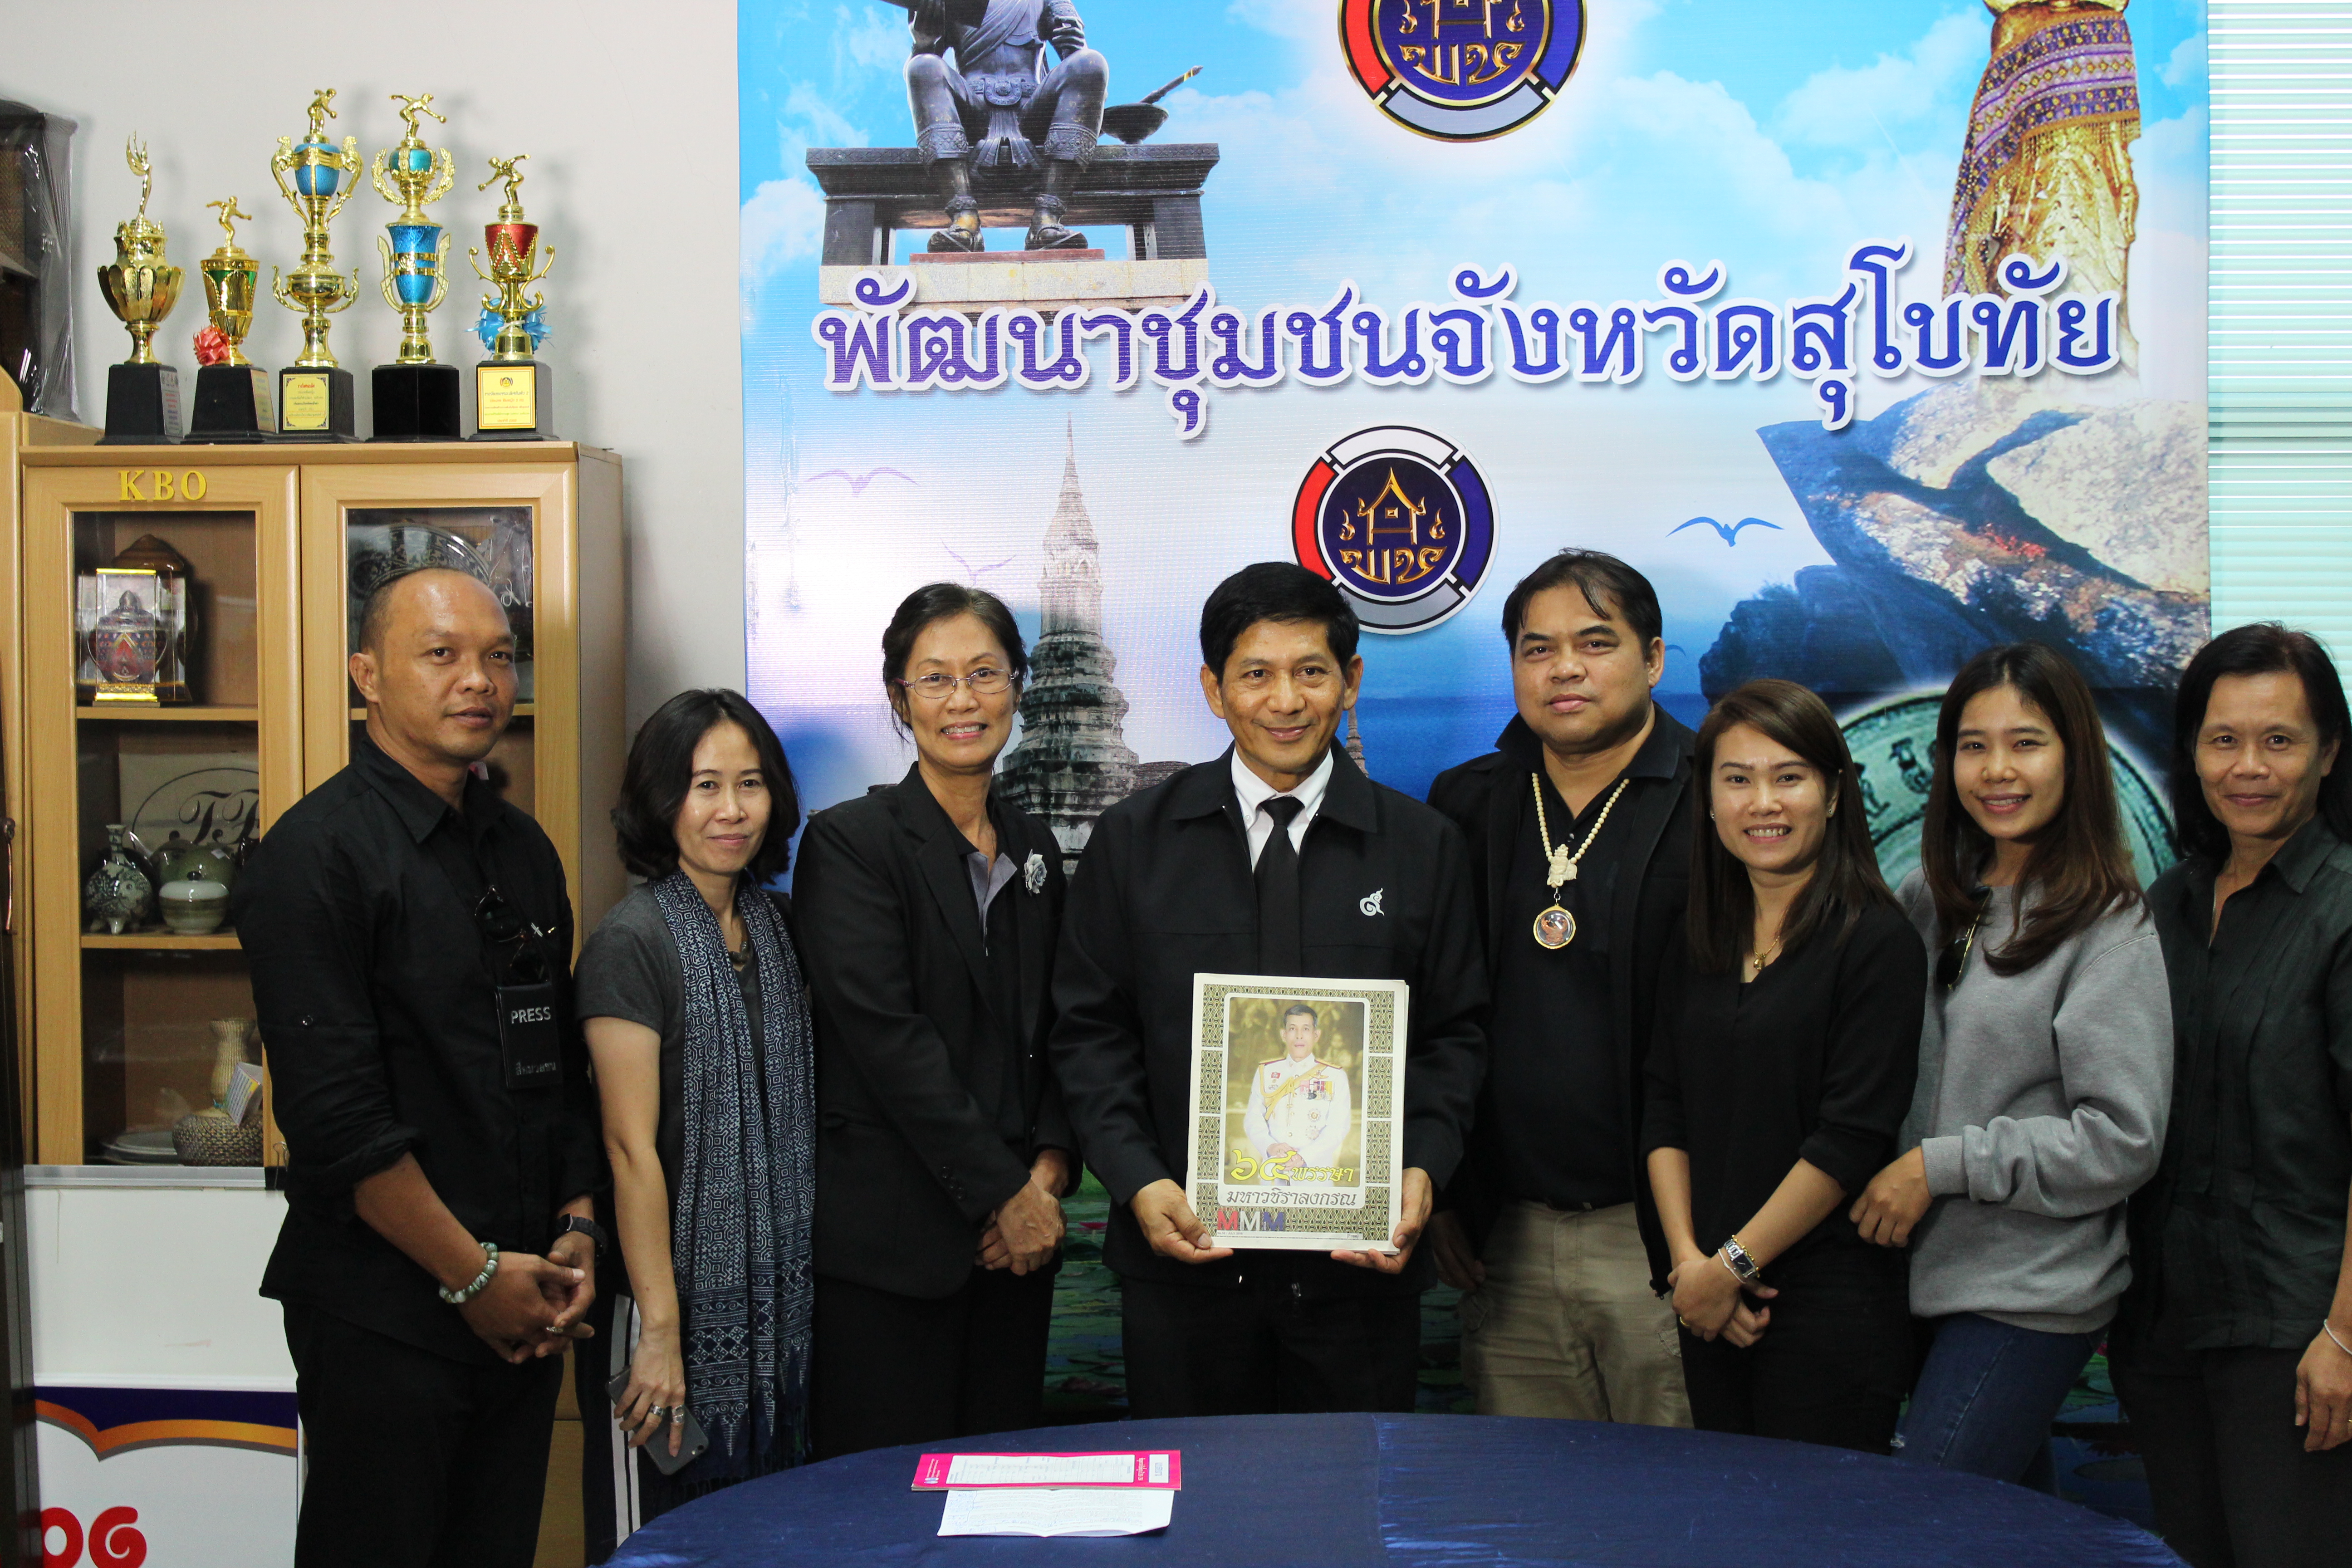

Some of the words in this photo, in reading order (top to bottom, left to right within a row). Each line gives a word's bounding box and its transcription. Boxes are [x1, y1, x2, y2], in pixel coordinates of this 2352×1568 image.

[818, 243, 2116, 432] พัฒนาชุมชนจังหวัดสุโขทัย
[118, 470, 207, 501] KBO
[511, 1006, 551, 1024] PRESS
[1230, 1149, 1298, 1181] ๖๔
[1291, 1166, 1355, 1183] พรรษา
[1226, 1187, 1357, 1206] มหาวชิราลงกรณ
